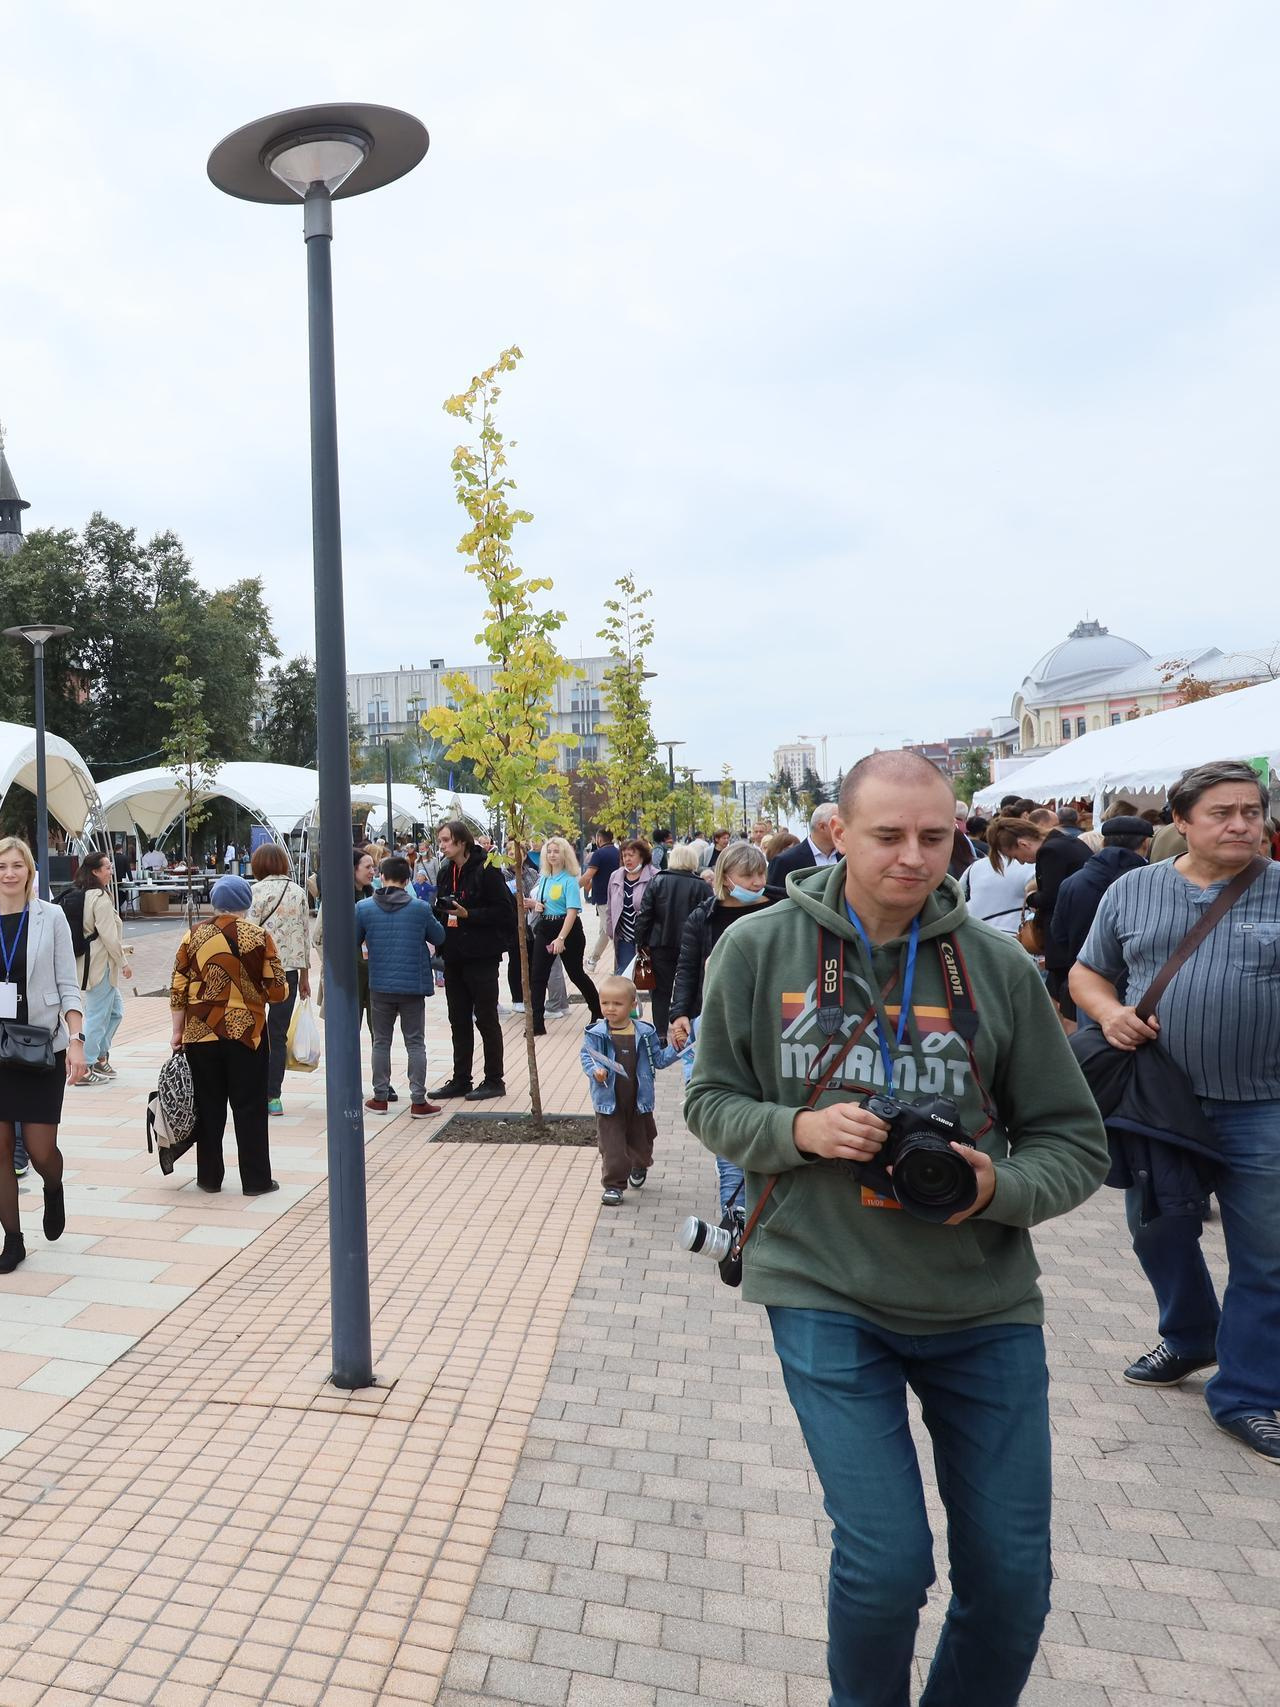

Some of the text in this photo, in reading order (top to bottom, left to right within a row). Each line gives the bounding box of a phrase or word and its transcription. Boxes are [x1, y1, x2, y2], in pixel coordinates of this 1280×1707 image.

[824, 958, 838, 994] EOS
[940, 942, 965, 996] Canon
[930, 1113, 954, 1128] Canon
